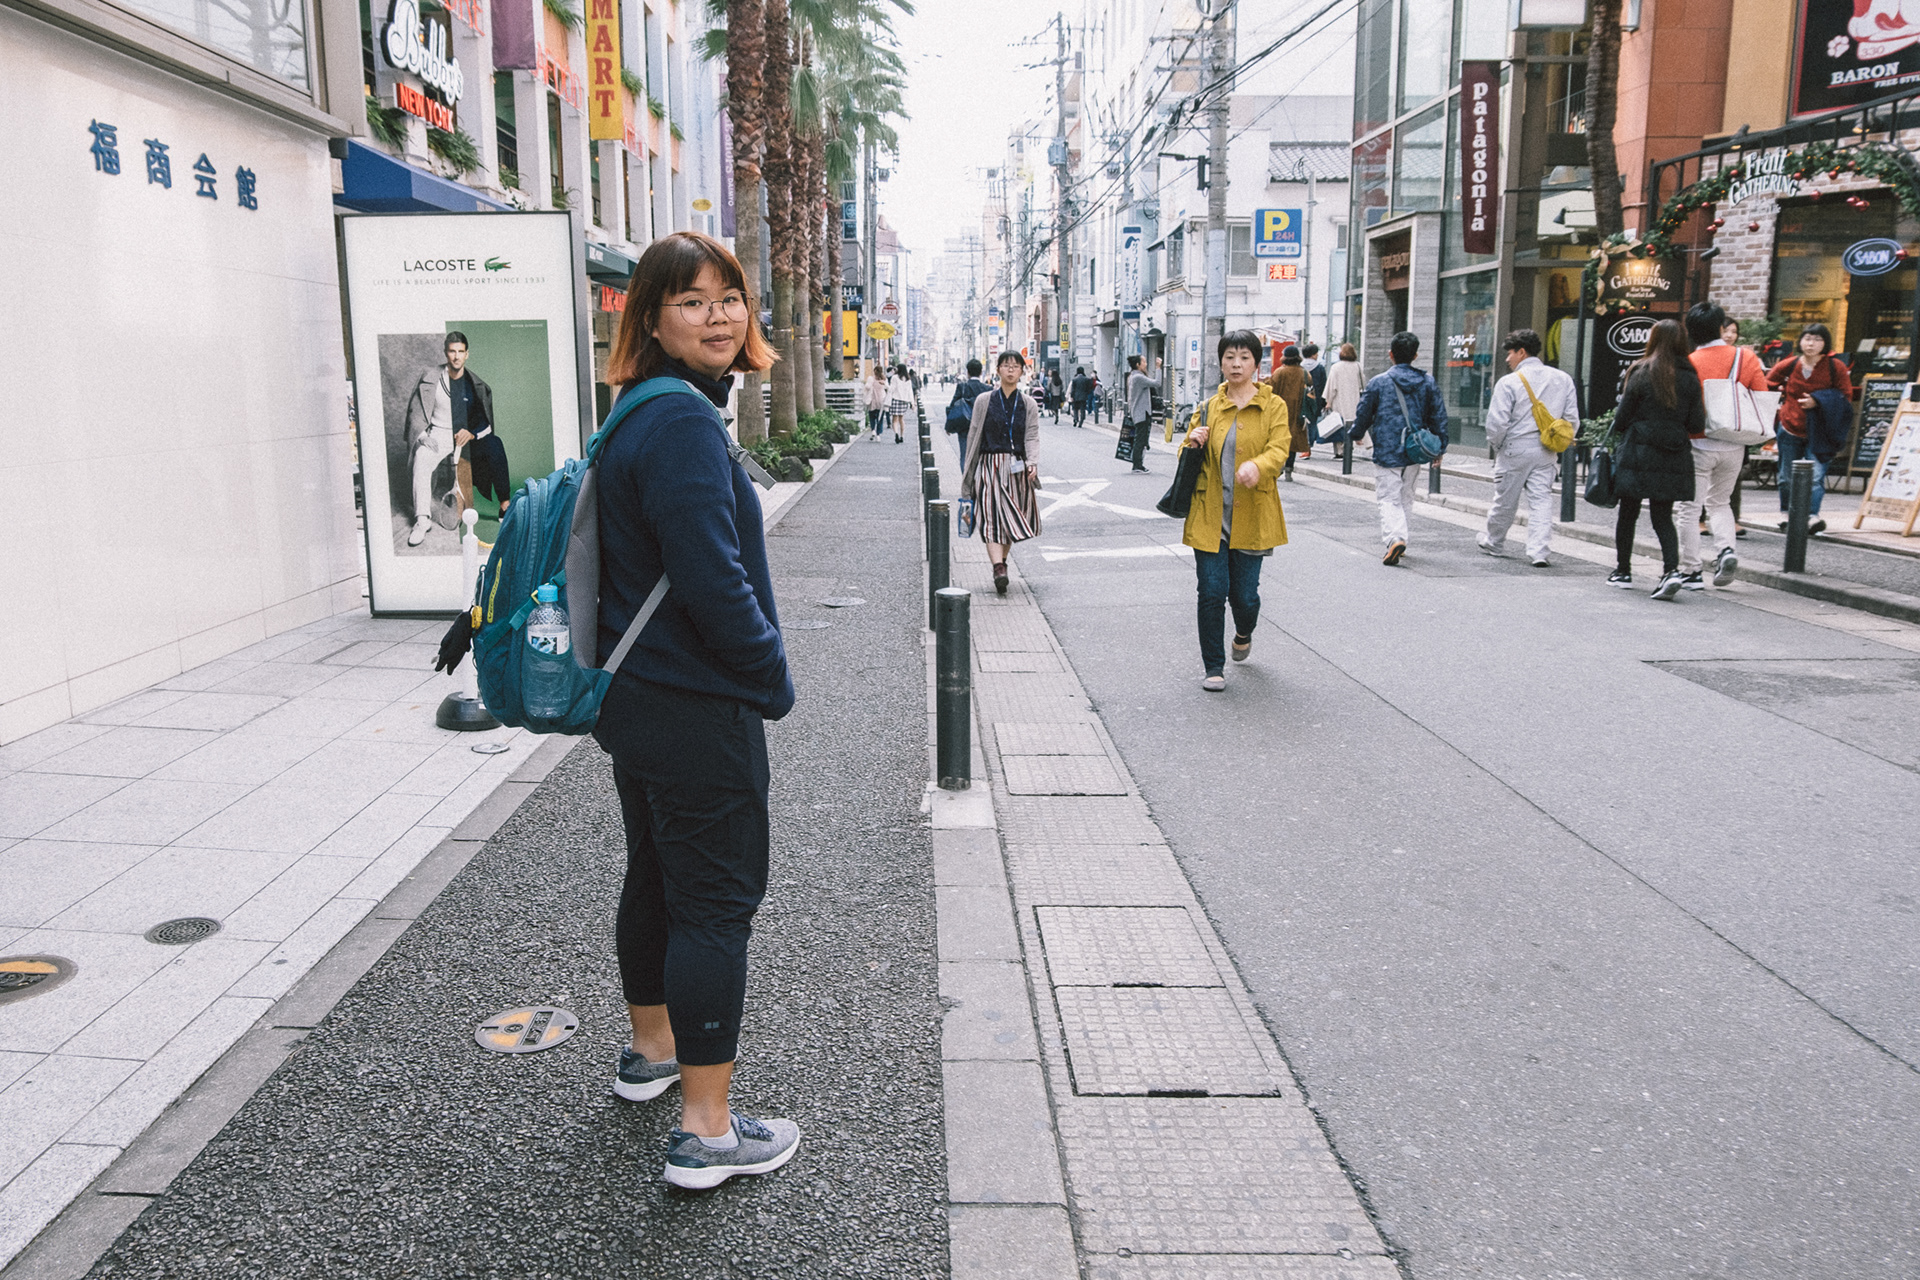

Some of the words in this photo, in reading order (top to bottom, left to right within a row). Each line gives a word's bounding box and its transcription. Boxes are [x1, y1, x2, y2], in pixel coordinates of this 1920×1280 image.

[591, 0, 615, 118] MART
[1830, 61, 1900, 86] BARON
[1874, 78, 1899, 89] FREE
[398, 83, 426, 118] NEW
[425, 96, 456, 134] YORK
[88, 118, 258, 211] 福商会館
[1471, 82, 1489, 231] patagonia
[1744, 147, 1789, 180] Fruit
[727, 178, 736, 207] DAIMYO
[1728, 173, 1800, 209] GATHERING
[1264, 211, 1290, 241] P
[1275, 231, 1295, 241] 24H
[403, 259, 477, 272] LACOSTE
[1853, 250, 1890, 266] SABON
[464, 277, 491, 285] SPORT
[524, 276, 546, 284] 1933
[1610, 275, 1671, 291] GATHERING
[1619, 327, 1651, 344] SABO
